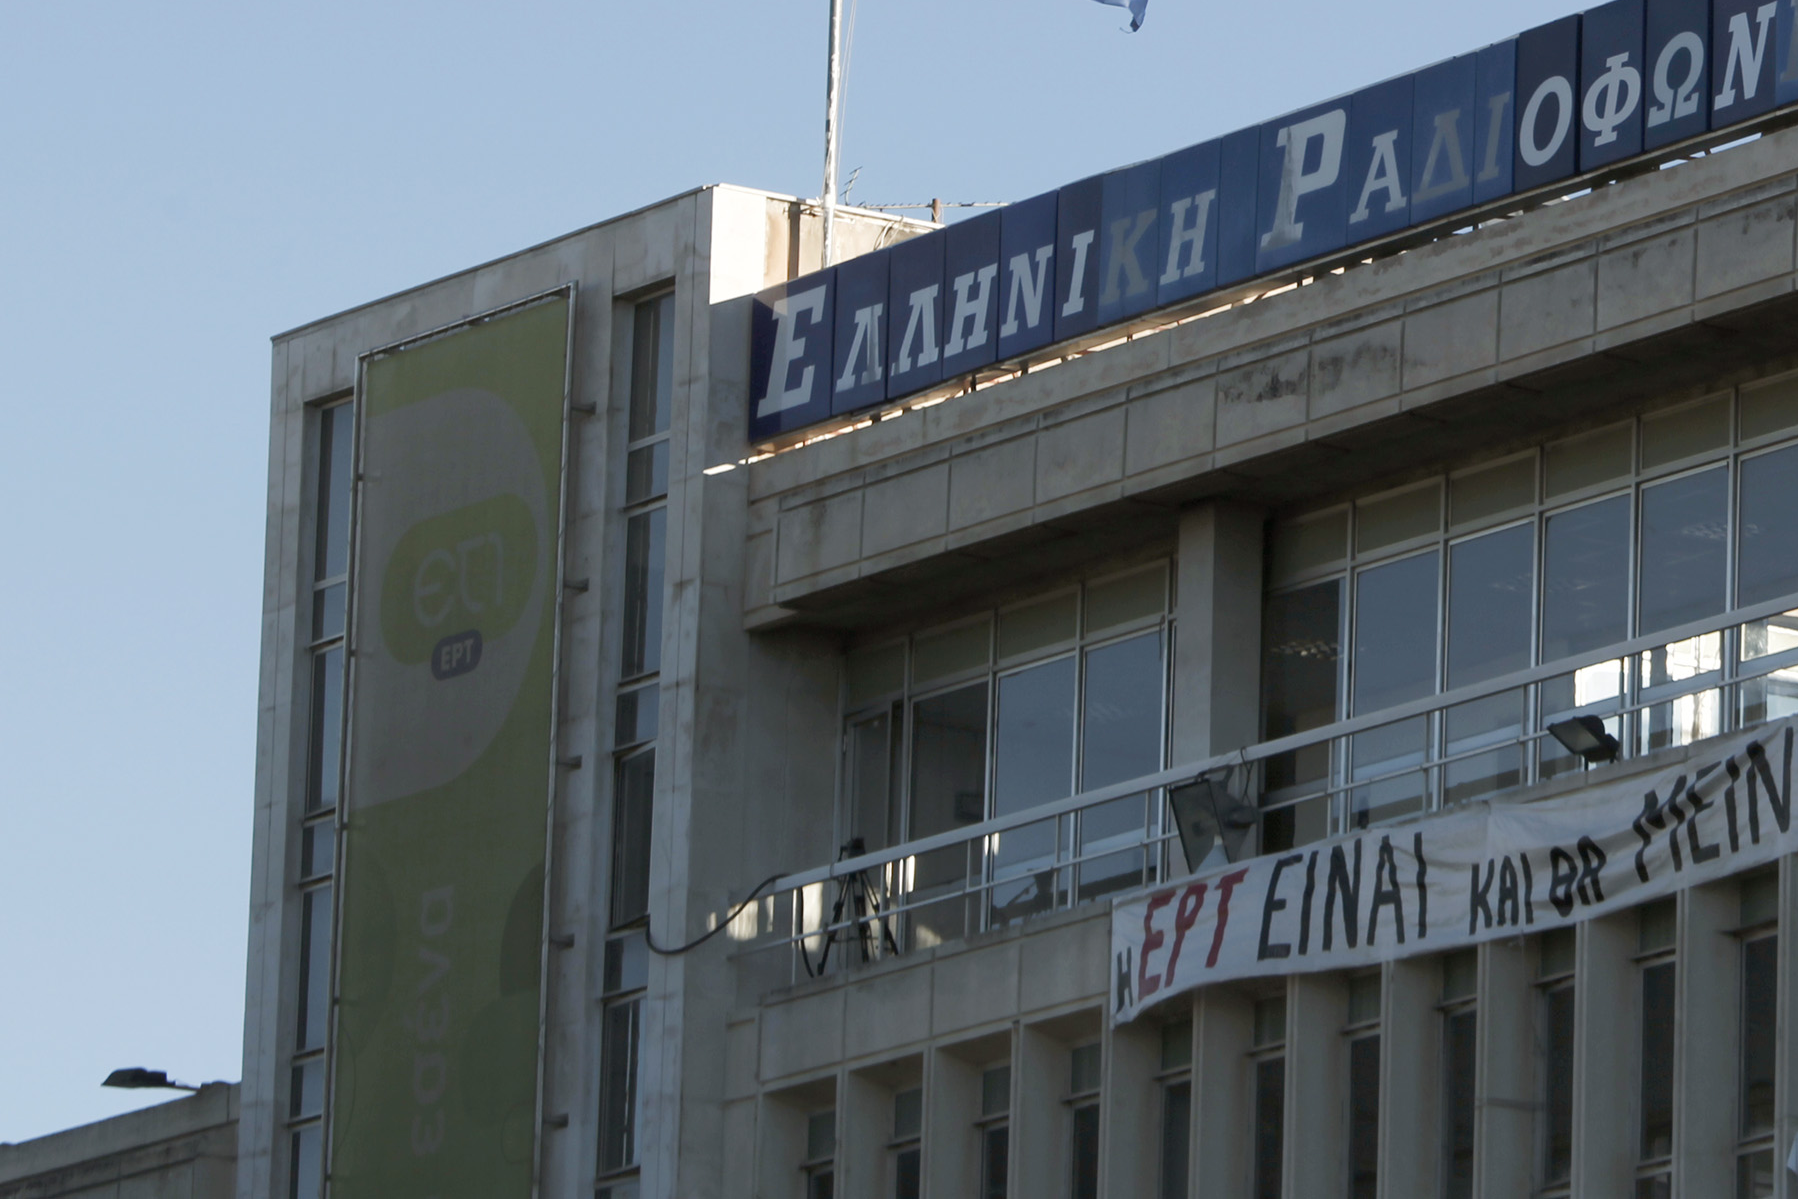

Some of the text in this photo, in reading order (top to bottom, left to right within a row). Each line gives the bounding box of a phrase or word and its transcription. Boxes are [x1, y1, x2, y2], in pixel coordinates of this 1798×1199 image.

[756, 188, 1216, 418] ΕΛΛΗΝΙΚΗ
[1138, 866, 1250, 1001] ΕΡΤ
[1257, 832, 1427, 961] ΕΙΝΑΙ
[1469, 852, 1534, 936] ΚΑΙ
